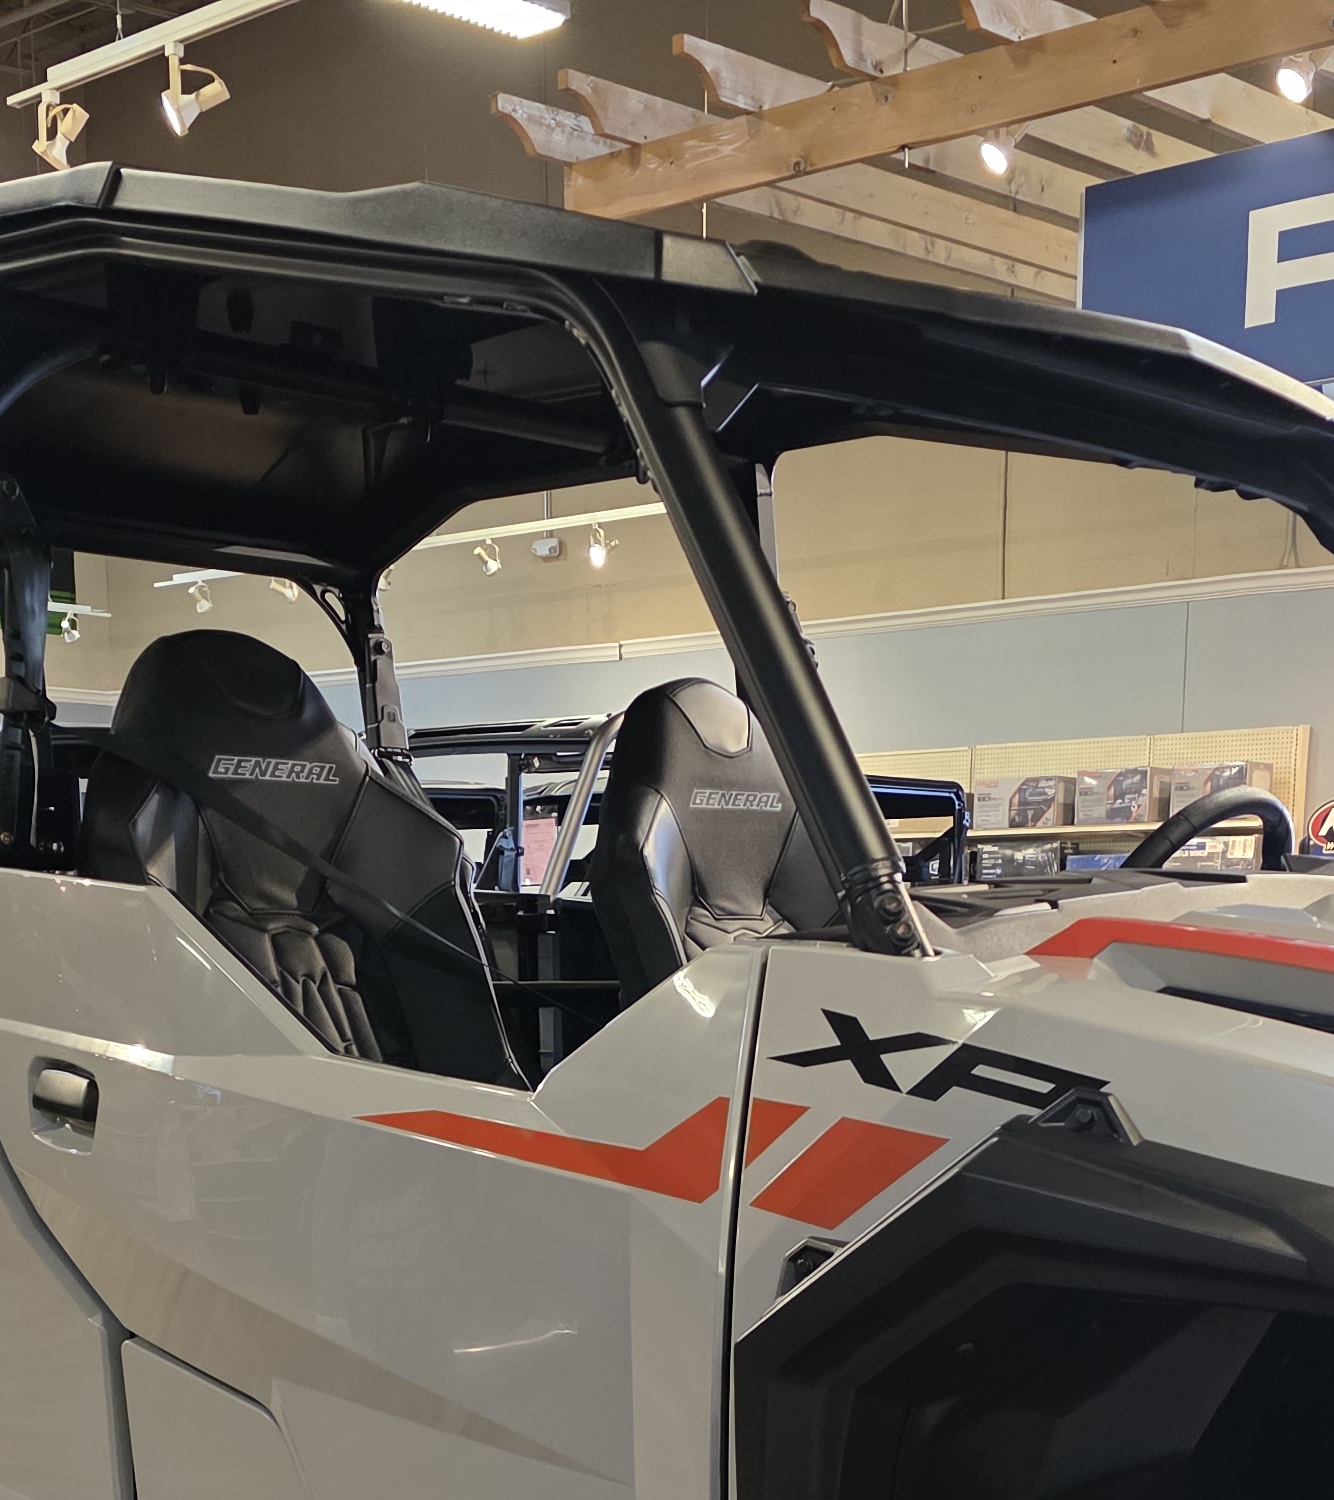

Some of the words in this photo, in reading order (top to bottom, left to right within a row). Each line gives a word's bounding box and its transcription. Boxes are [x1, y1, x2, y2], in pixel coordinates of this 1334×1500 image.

[208, 755, 339, 785] GENERAL
[690, 789, 782, 812] GENERAL
[765, 1007, 1112, 1111] XP
